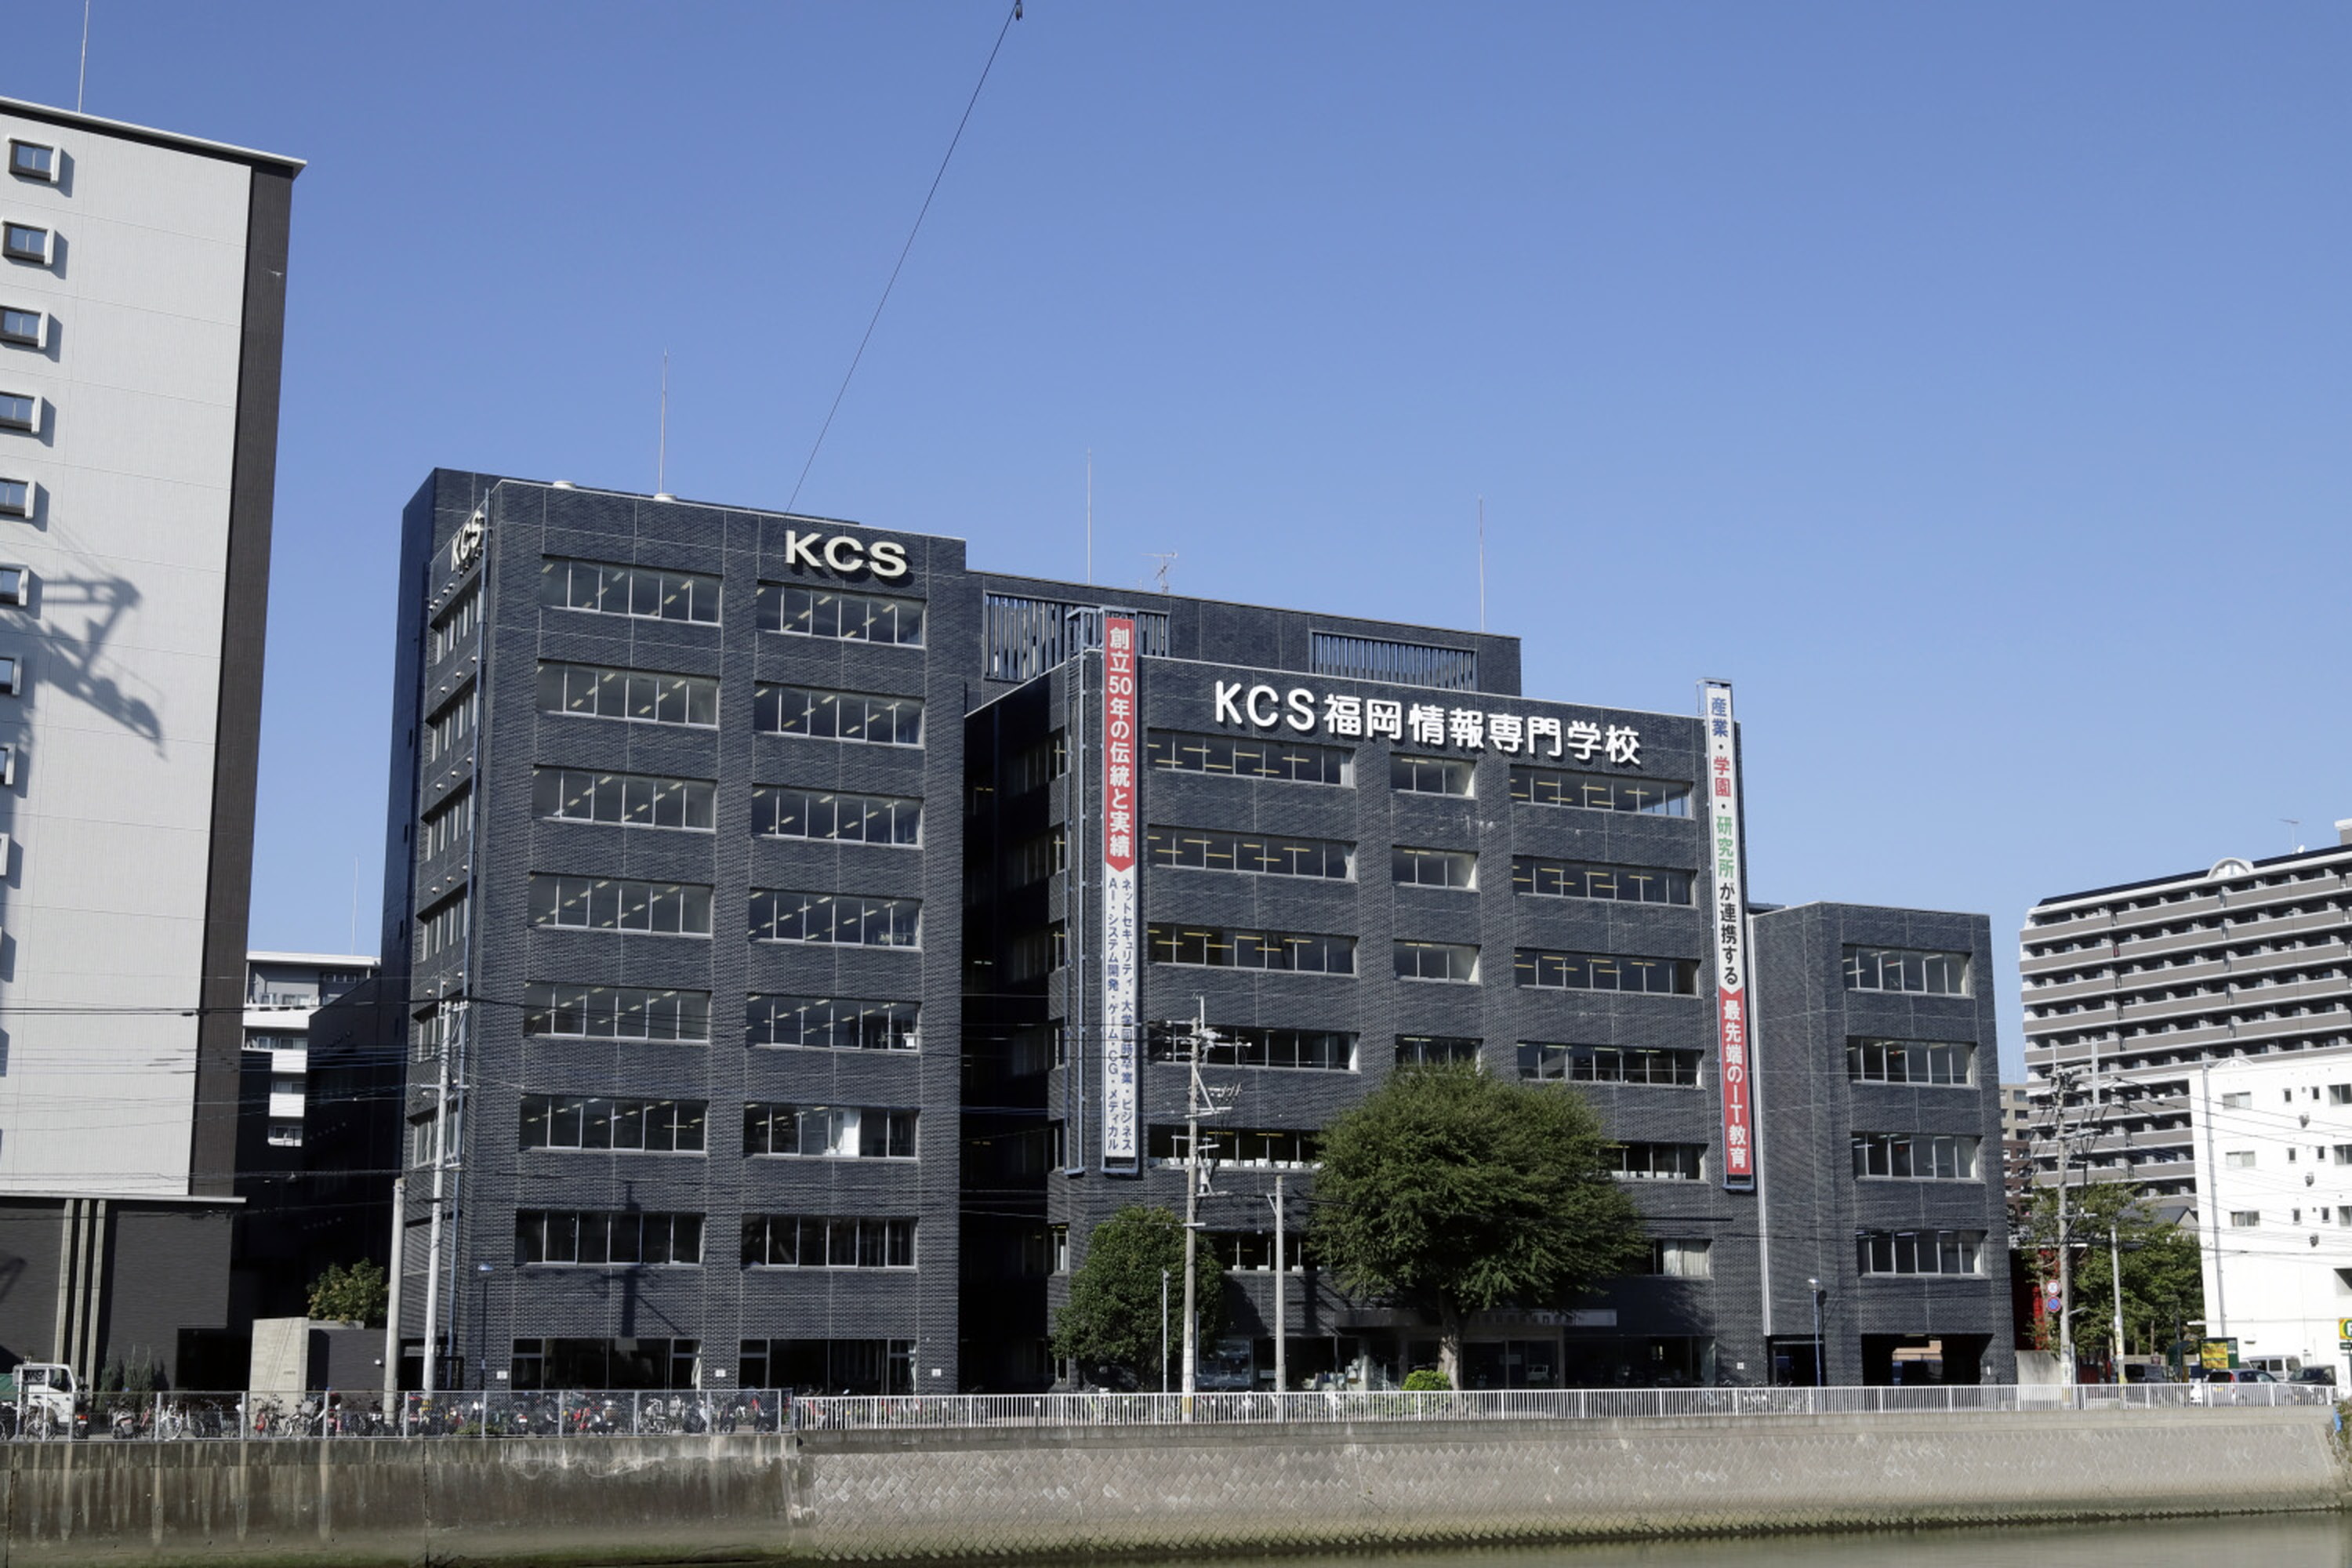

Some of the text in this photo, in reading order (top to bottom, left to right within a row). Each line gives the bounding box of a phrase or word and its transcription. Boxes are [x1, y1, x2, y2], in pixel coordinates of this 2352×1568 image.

[452, 510, 485, 571] KCS
[785, 530, 908, 577] KCS
[1108, 627, 1132, 858] 創立50年の伝統と実績
[1214, 681, 1641, 764] KCS福岡情報専門学校
[1711, 697, 1738, 985] 産業・学園・研究所が連携する
[1723, 1000, 1746, 1168] 最先端のIT教育
